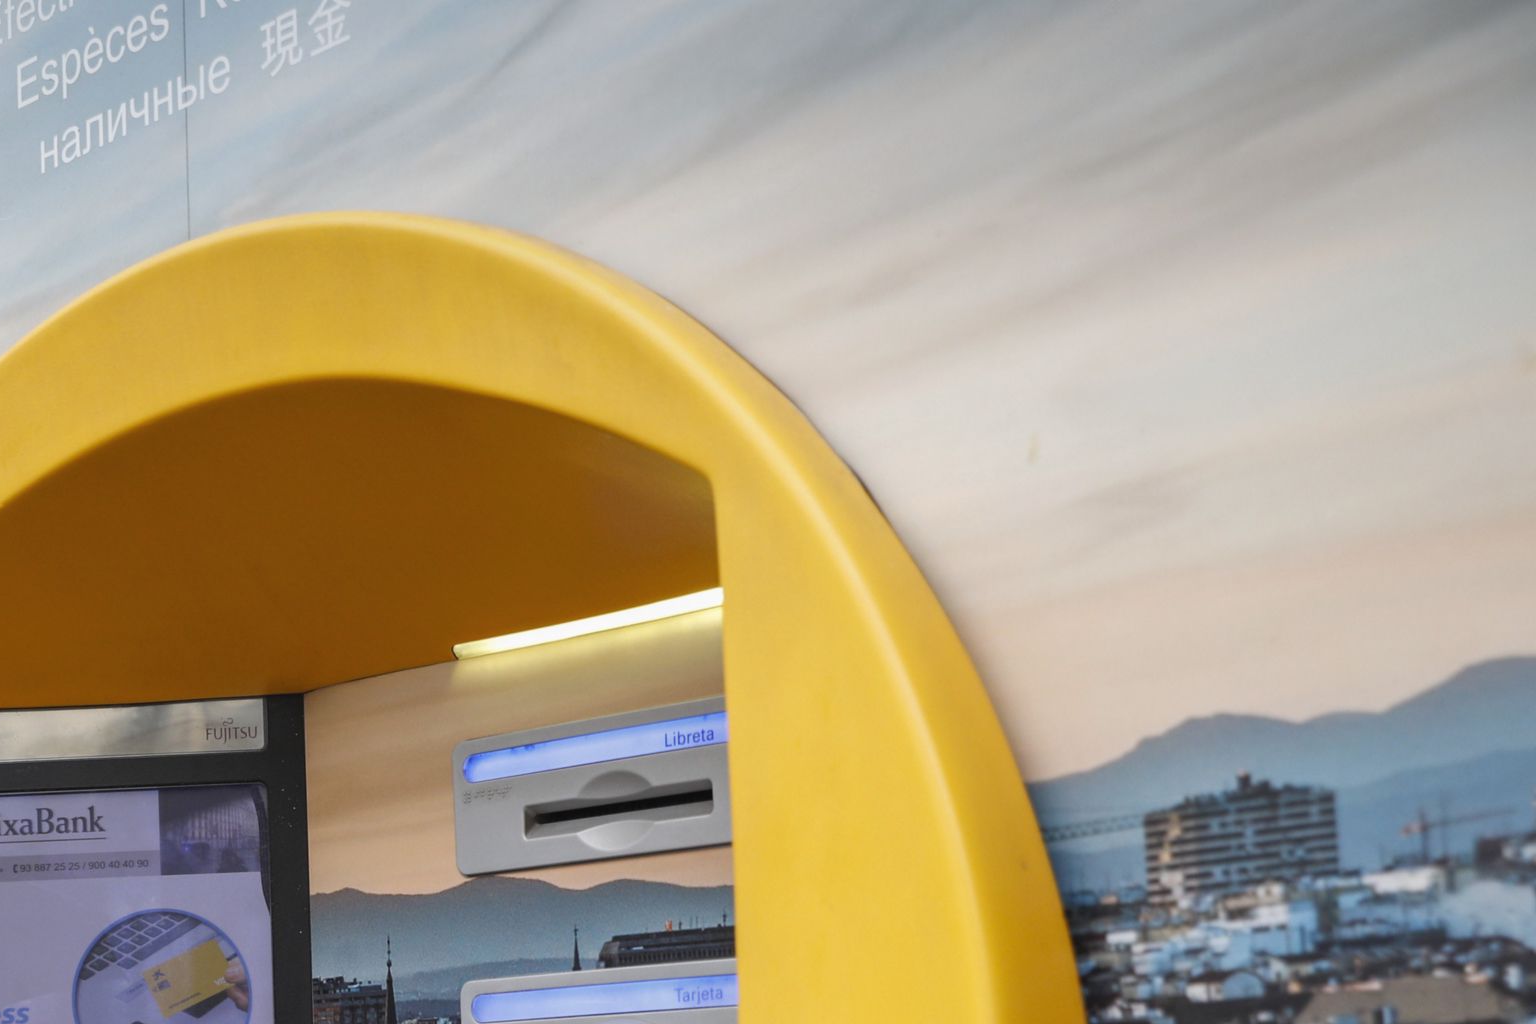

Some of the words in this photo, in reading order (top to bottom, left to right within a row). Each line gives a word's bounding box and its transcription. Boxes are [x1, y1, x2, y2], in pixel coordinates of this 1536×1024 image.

[260, 0, 351, 77] 現金
[16, 4, 169, 109] Espèces
[39, 55, 232, 174] наличные
[206, 726, 257, 744] FUJITSU
[664, 729, 715, 748] Libreta
[88, 860, 106, 870] 900
[108, 860, 120, 869] 40
[122, 859, 134, 868] 40
[137, 859, 149, 868] 90
[674, 987, 723, 1005] Tarjeta
